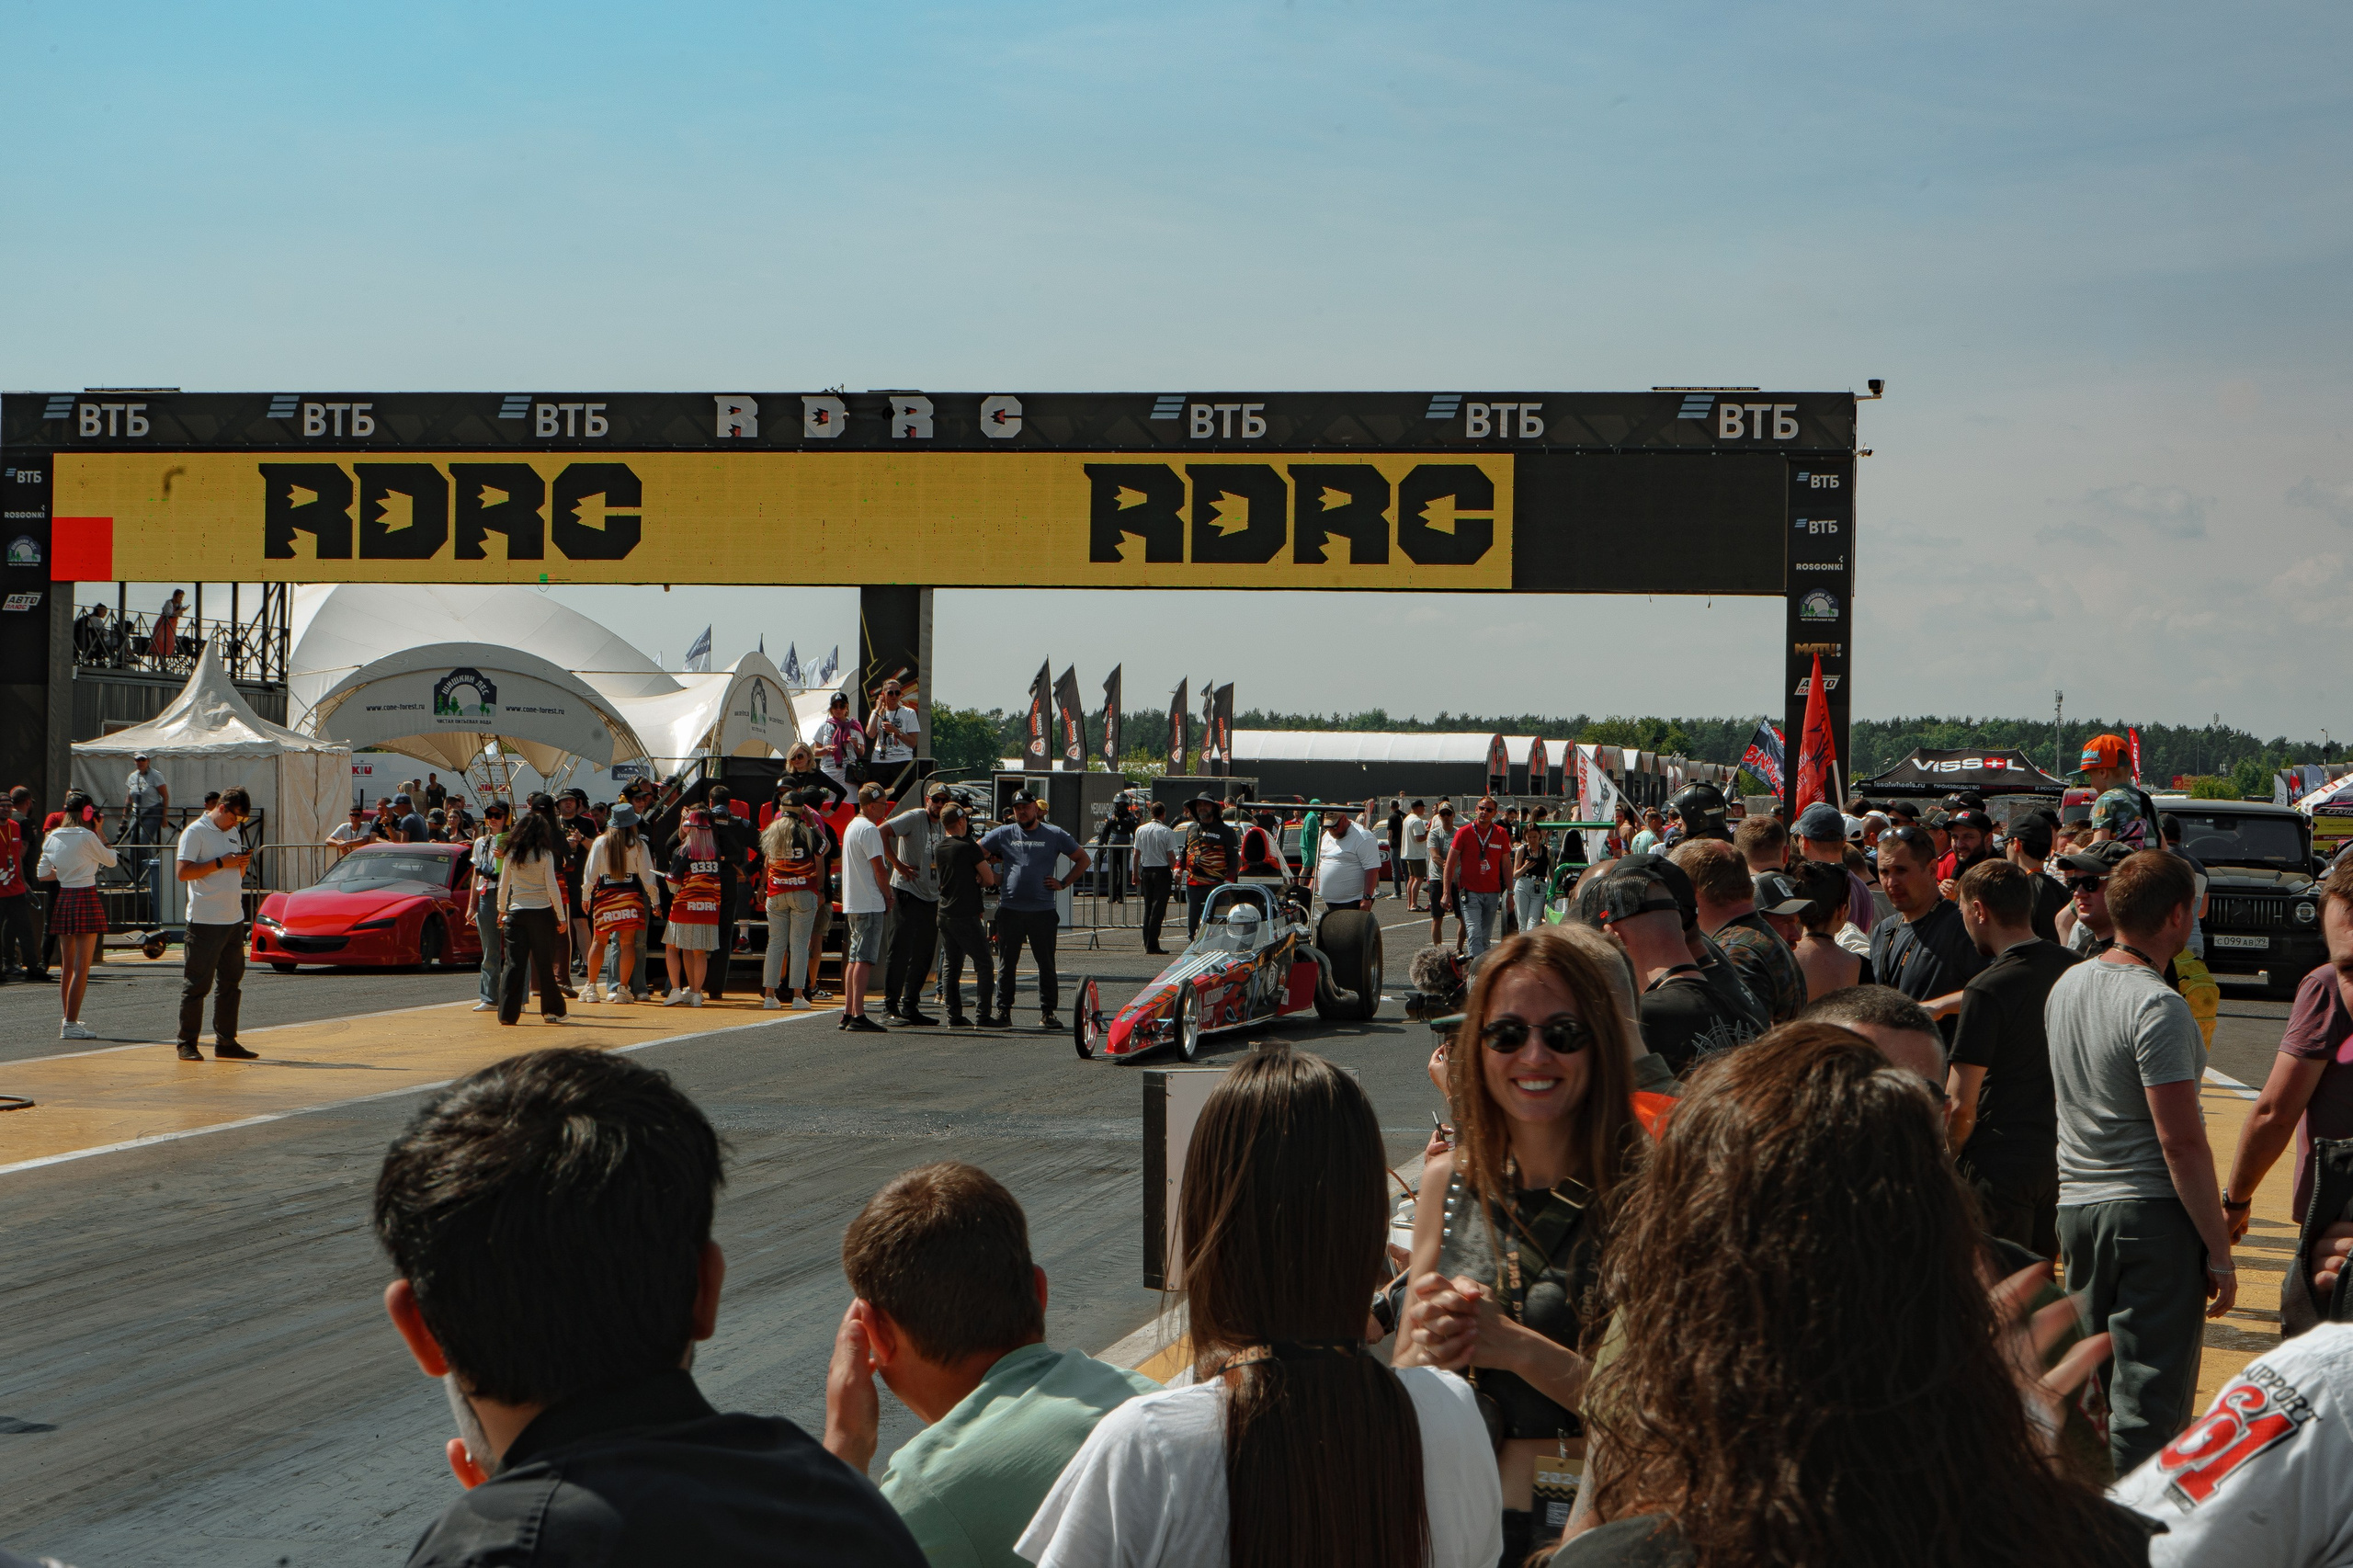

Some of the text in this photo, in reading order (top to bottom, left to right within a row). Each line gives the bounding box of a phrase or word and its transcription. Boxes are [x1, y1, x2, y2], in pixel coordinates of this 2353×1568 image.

[80, 403, 149, 437] ВТБ
[303, 403, 375, 437] ВТБ
[536, 403, 608, 437] ВТБ
[1190, 403, 1267, 438] ВТБ
[1466, 403, 1544, 438] ВТБ
[1719, 403, 1799, 439] ВТБ
[17, 471, 42, 483] ВТБ
[1811, 474, 1839, 488] ВТБ
[258, 462, 642, 561] RDRC
[1084, 462, 1495, 565] RDRC
[1809, 520, 1838, 534] ВТБ
[441, 675, 490, 697] ШИШКИН ЛЕС
[365, 703, 426, 712] www.cone-forest.ru
[505, 705, 565, 715] www.cone-forest.ru
[689, 861, 719, 874] 8333
[602, 908, 639, 923] RDRC
